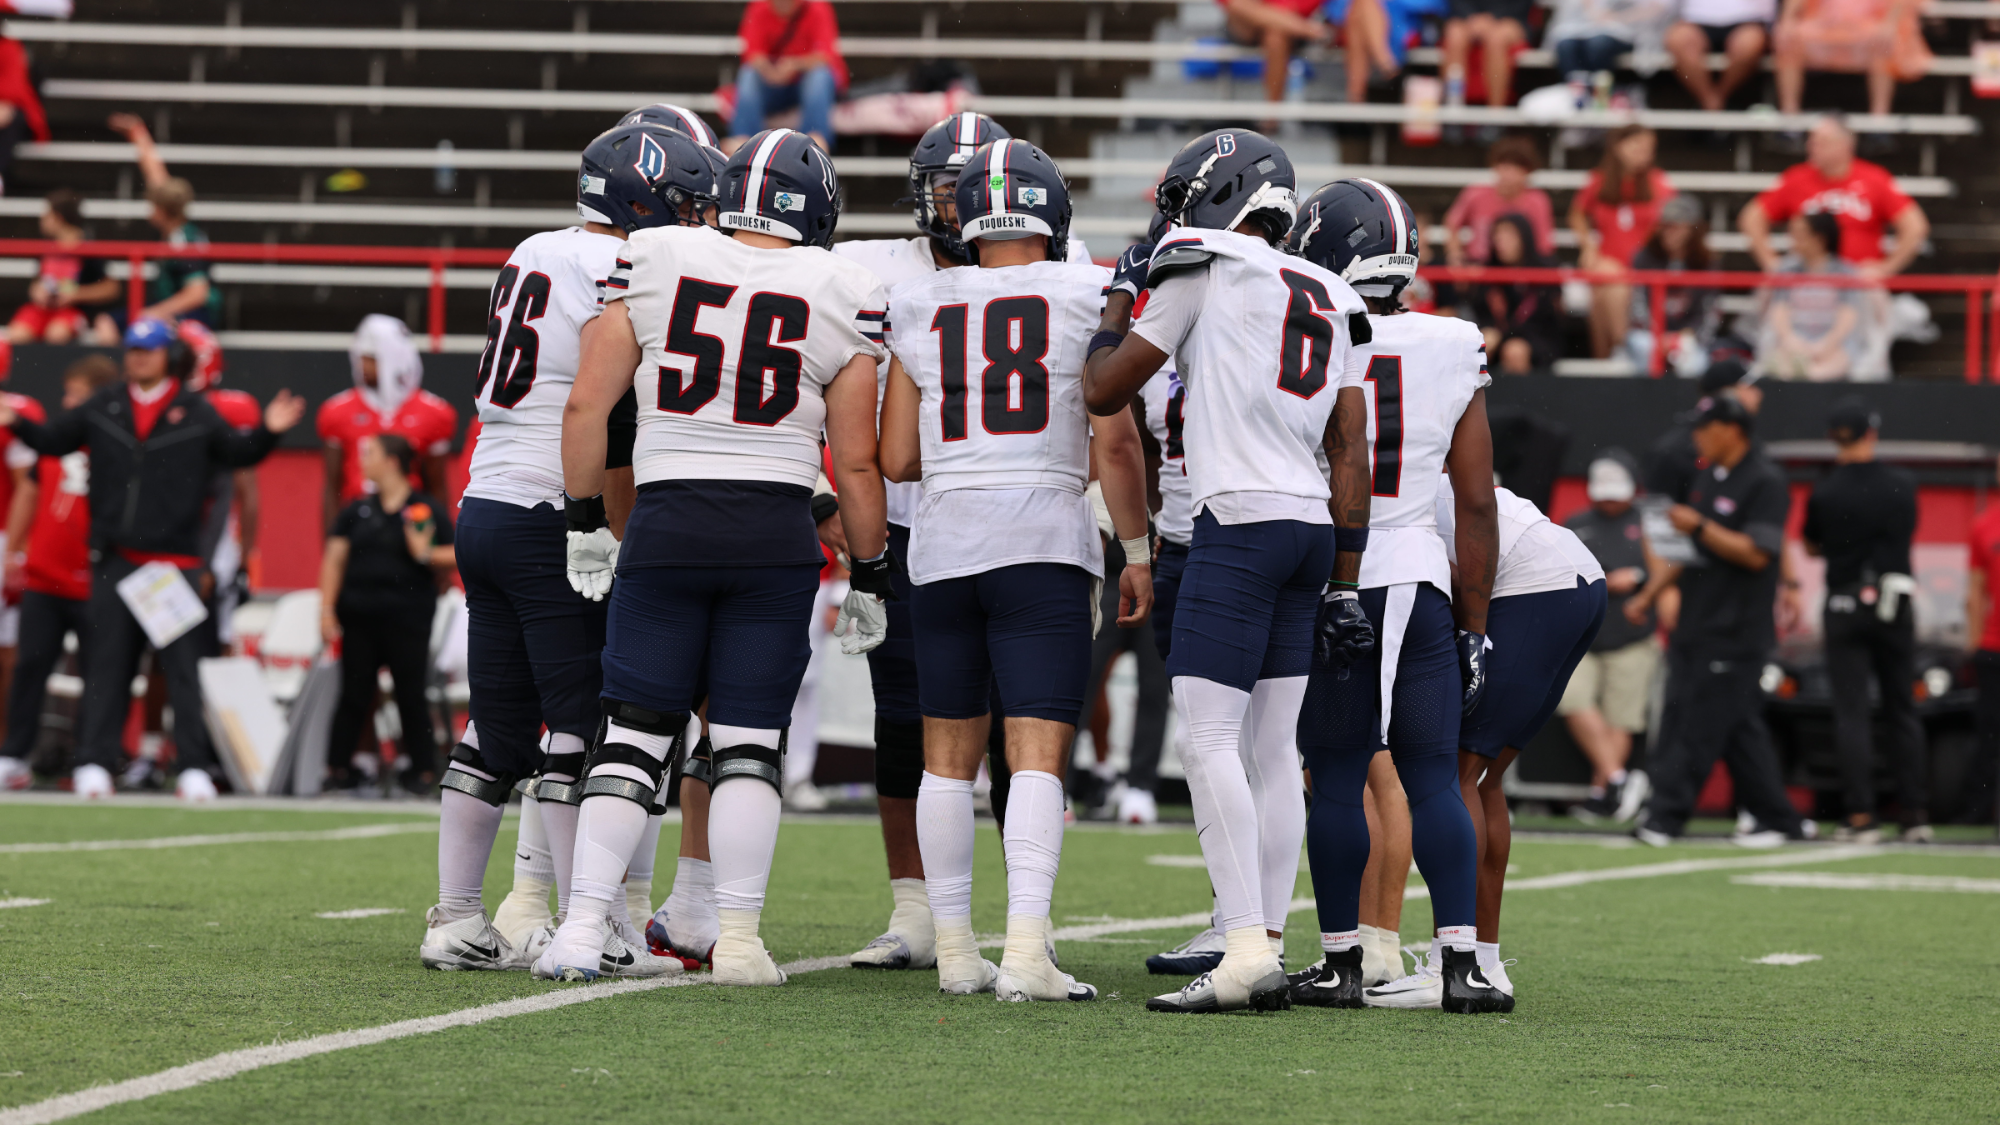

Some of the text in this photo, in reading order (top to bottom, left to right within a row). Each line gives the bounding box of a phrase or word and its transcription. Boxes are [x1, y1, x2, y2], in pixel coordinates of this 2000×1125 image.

[1216, 133, 1236, 158] 6
[728, 214, 771, 231] DUQUESNE
[979, 216, 1026, 231] DUQUESNE
[473, 263, 551, 409] 66
[657, 276, 810, 427] 56
[930, 294, 1050, 443] 18
[1277, 267, 1337, 400] 6
[1364, 354, 1404, 498] 1
